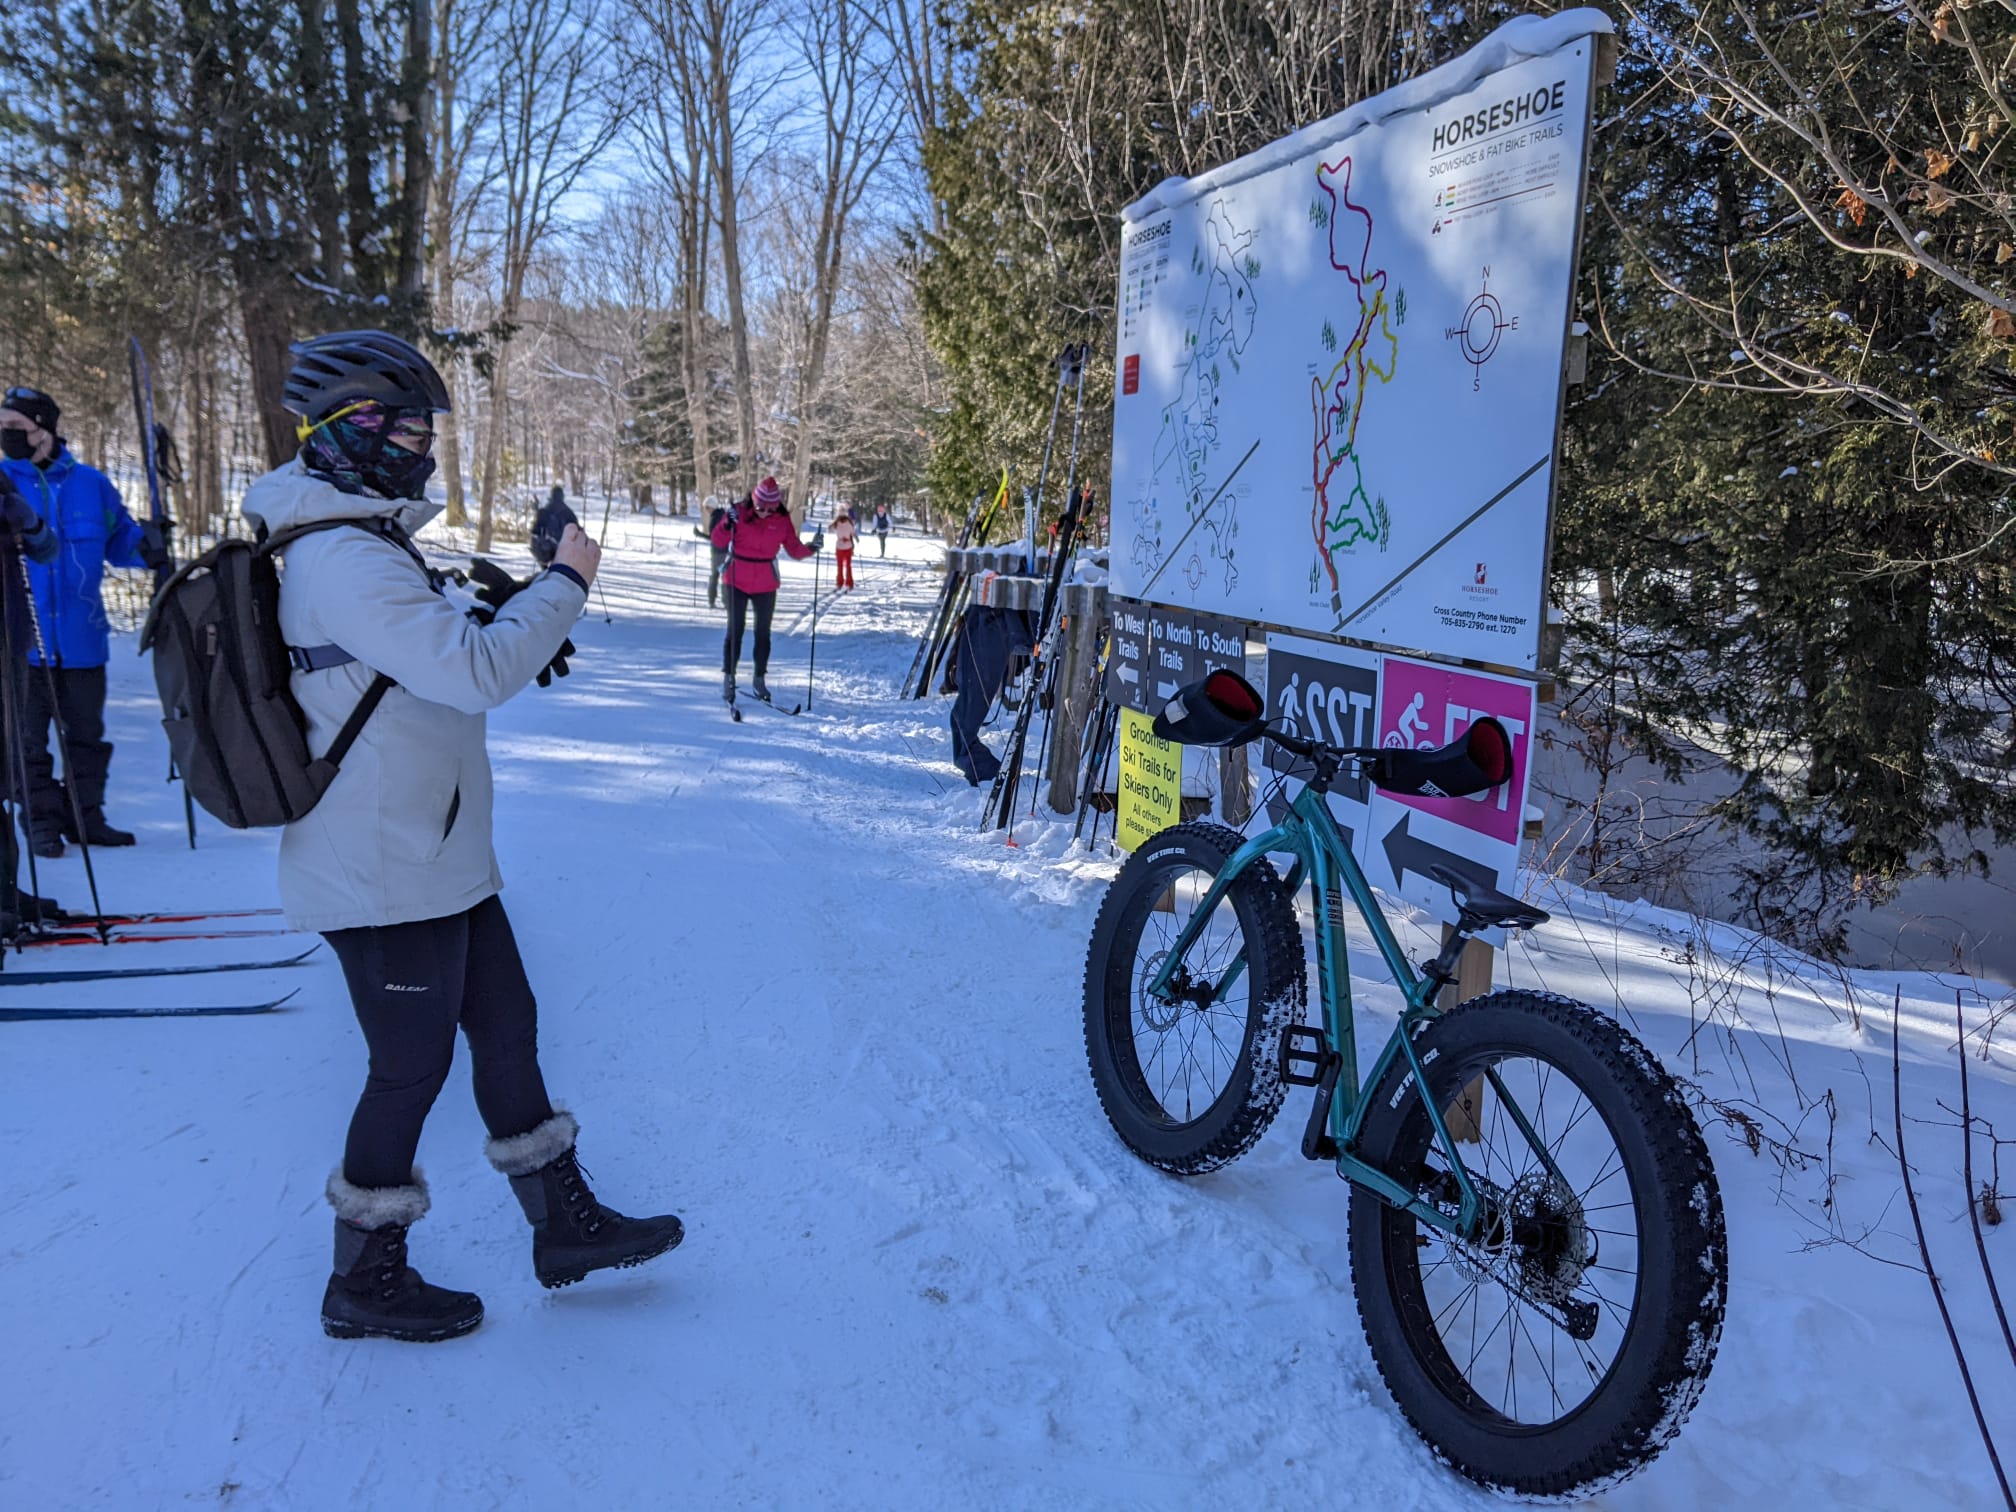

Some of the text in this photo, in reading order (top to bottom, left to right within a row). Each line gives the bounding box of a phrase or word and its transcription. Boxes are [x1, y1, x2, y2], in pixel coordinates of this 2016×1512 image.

[1432, 80, 1566, 152] HORSESHOE
[1429, 123, 1563, 178] SNOWSHOE & FAT BIKE TRAILS
[1128, 220, 1171, 248] HORSESHOE
[1482, 265, 1491, 279] N
[1445, 327, 1455, 341] W
[1511, 316, 1519, 330] E
[1473, 379, 1480, 392] S
[1461, 585, 1498, 595] HORSESHOE
[1113, 611, 1145, 636] To West
[1433, 605, 1527, 625] Cross Country Phone Number
[1440, 616, 1517, 635] 705-835-2790 ext. 1270
[1152, 619, 1192, 645] To North
[1197, 629, 1242, 658] To South
[1118, 638, 1139, 660] Trails
[1158, 647, 1183, 671] Trails
[1306, 681, 1372, 779] SST
[1123, 745, 1177, 783] Ski Trails for
[1444, 703, 1525, 811] FT
[1124, 773, 1173, 814] Skiers Only
[1126, 817, 1145, 834] please
[1133, 803, 1162, 827] All others
[1389, 1083, 1406, 1109] VEE
